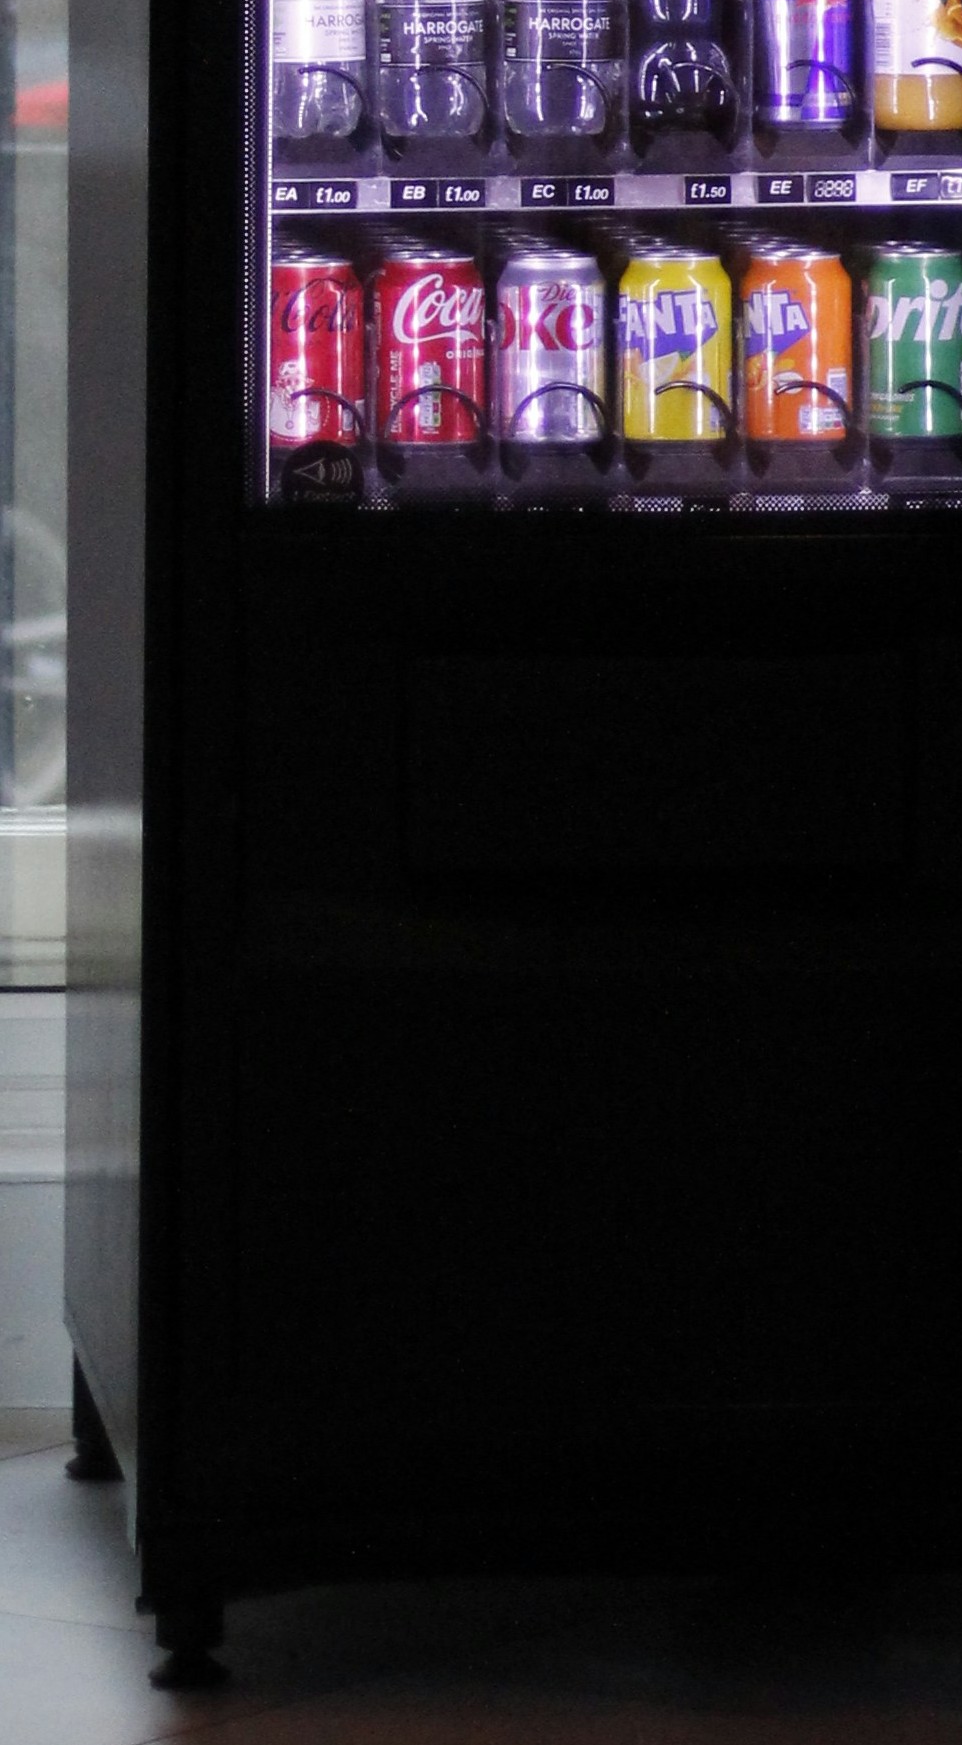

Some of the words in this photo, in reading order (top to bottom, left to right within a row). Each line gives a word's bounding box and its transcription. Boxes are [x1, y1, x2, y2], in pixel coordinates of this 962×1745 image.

[403, 19, 484, 35] HARROGATE
[528, 16, 611, 31] HARROGATE
[532, 185, 556, 199] EC
[574, 185, 610, 201] £1.00
[690, 182, 727, 199] £1.50
[770, 180, 792, 194] EE
[906, 178, 927, 193] EF
[274, 187, 298, 201] EA
[316, 187, 351, 203] £1.00
[402, 186, 426, 200] EB
[445, 187, 480, 203] £1.00
[537, 282, 577, 302] Die
